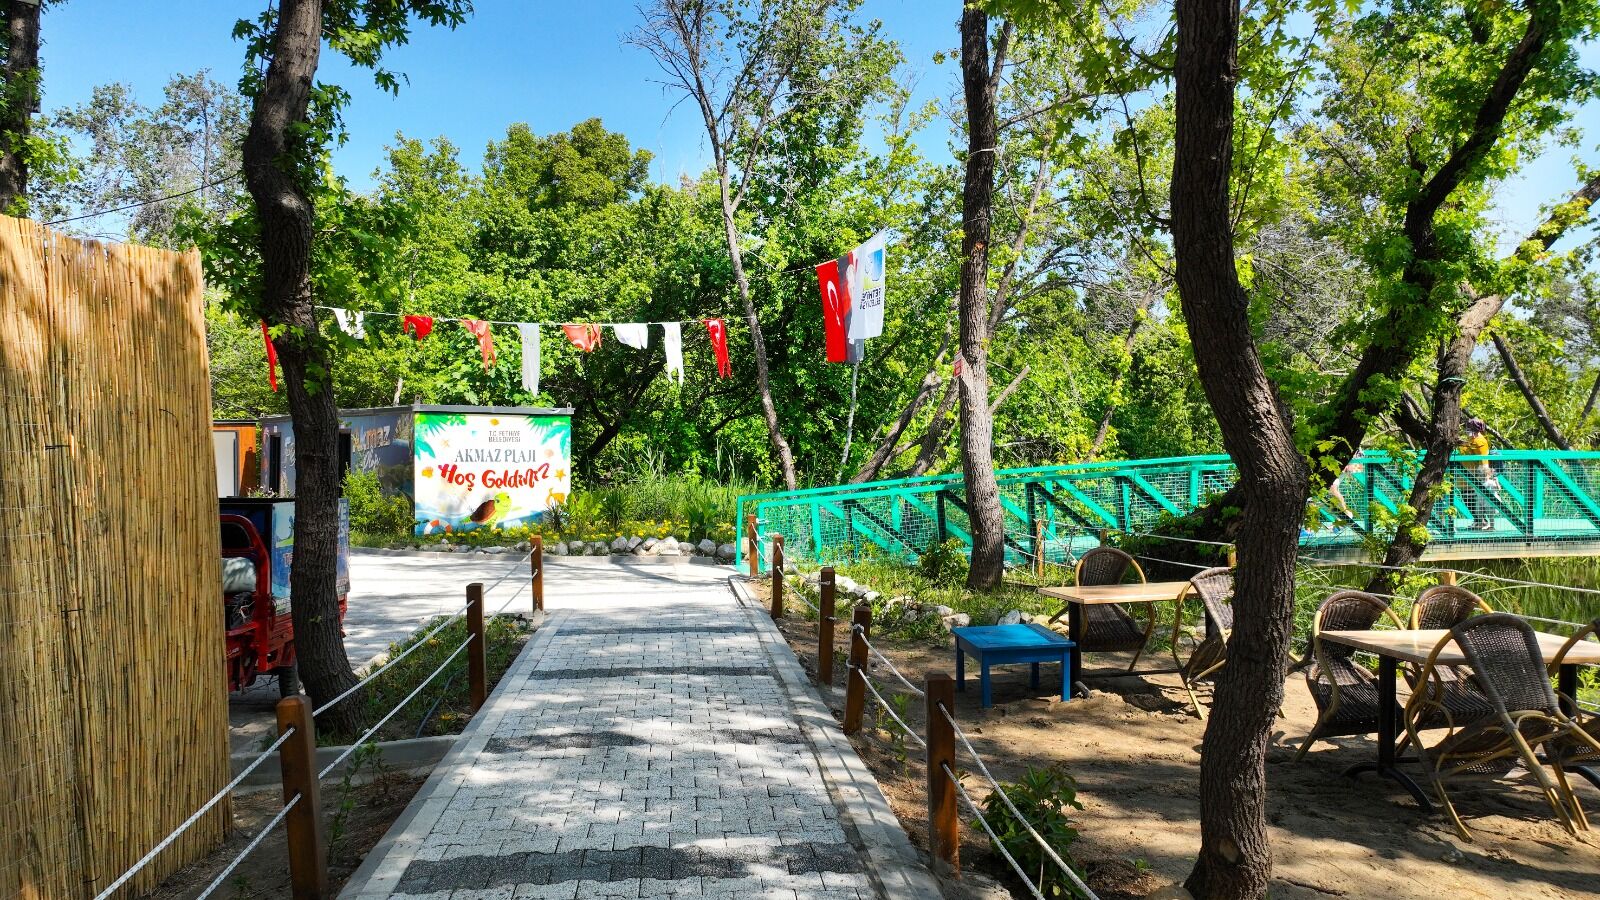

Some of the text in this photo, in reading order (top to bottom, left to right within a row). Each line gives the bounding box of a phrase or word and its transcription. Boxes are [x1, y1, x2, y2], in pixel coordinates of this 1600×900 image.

[455, 449, 536, 463] AKMAZ PLAJI
[438, 463, 475, 491] Hoş
